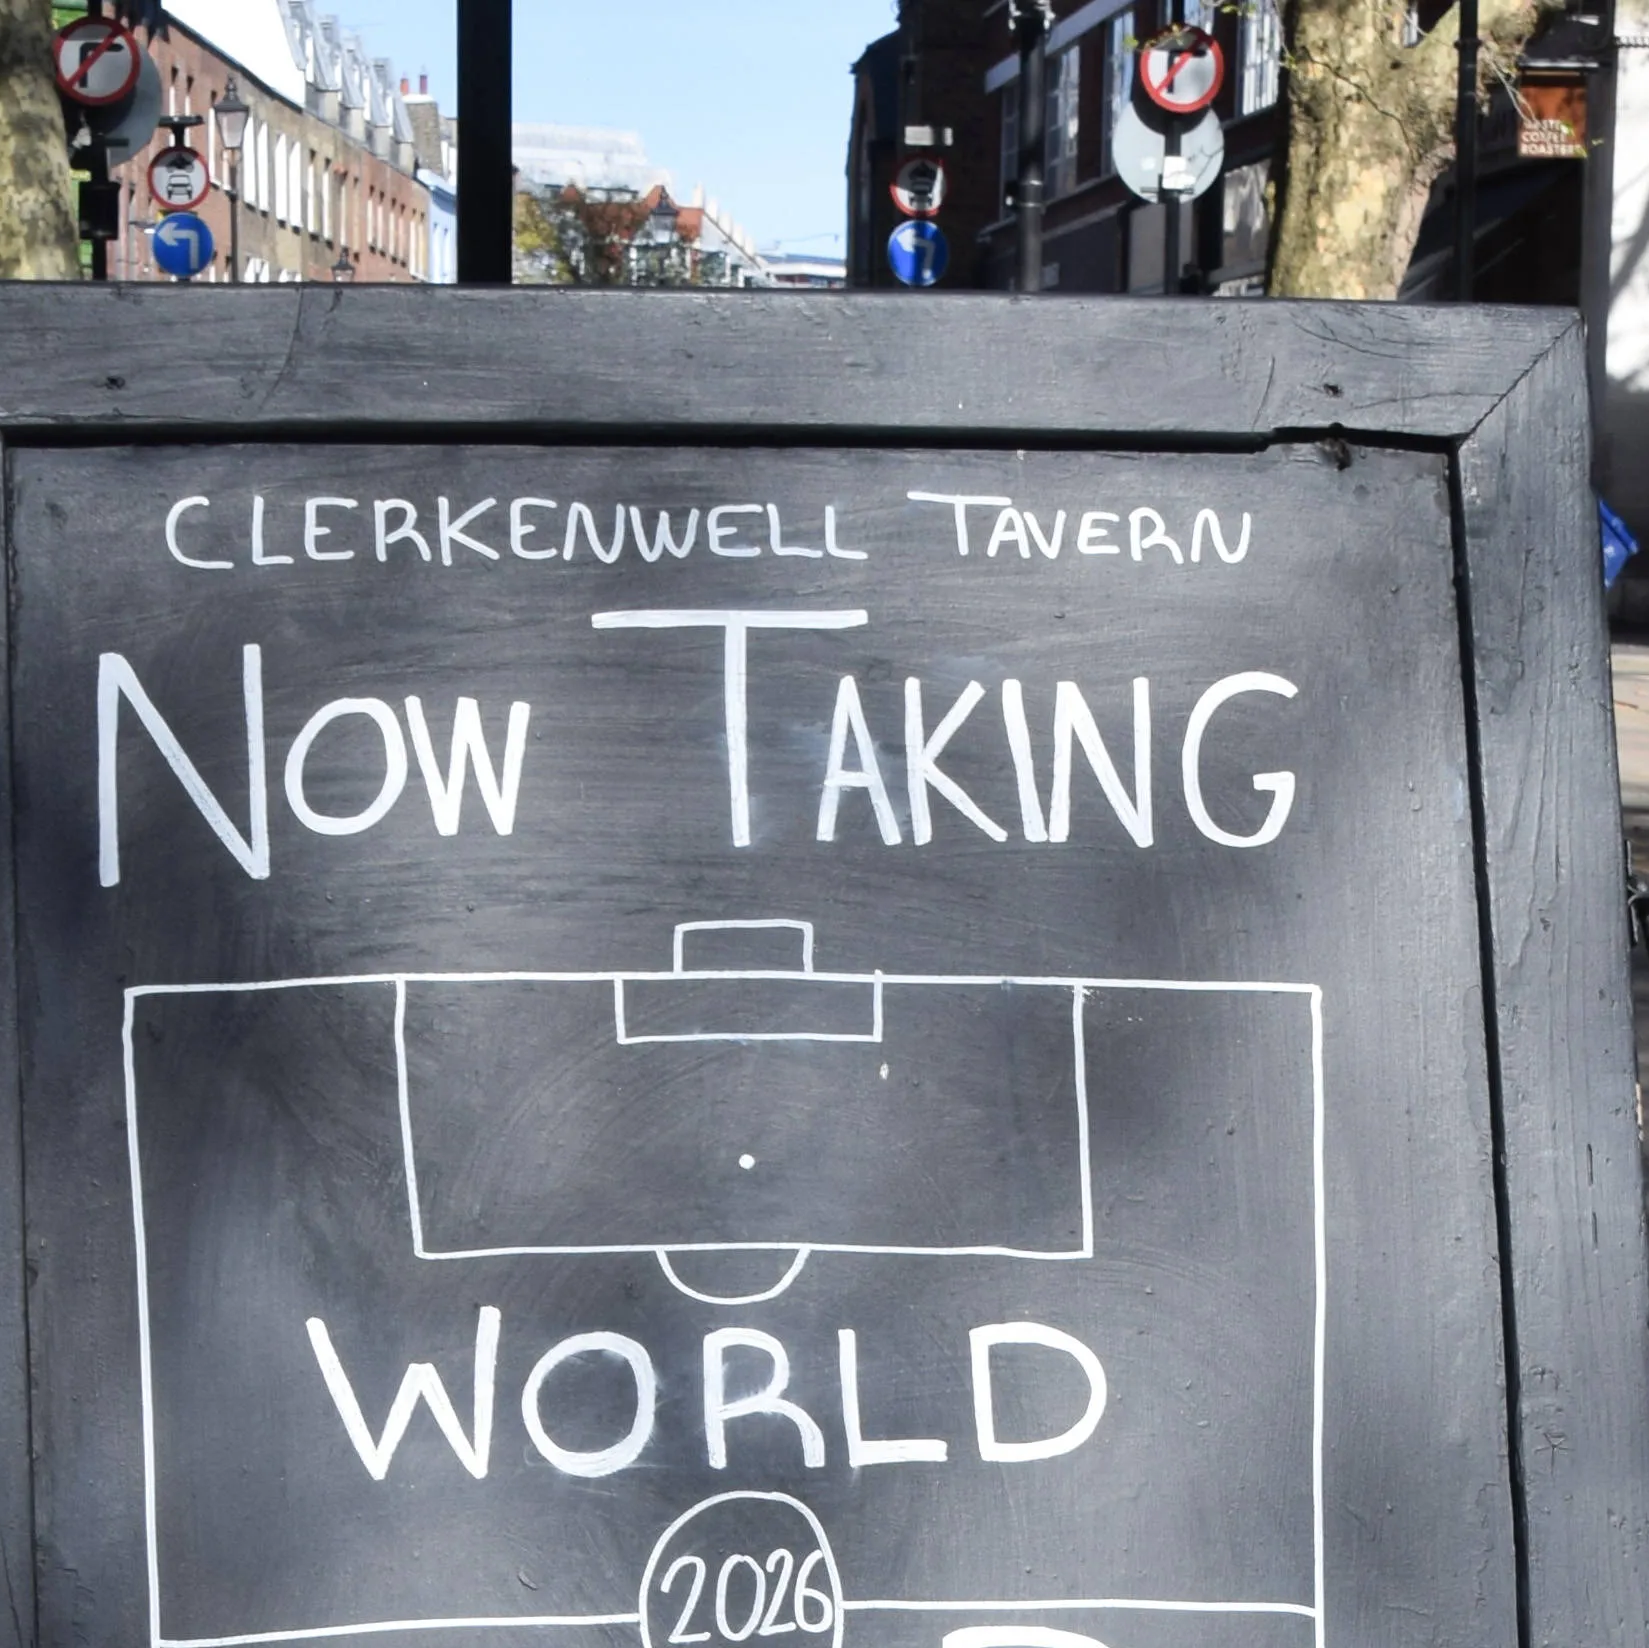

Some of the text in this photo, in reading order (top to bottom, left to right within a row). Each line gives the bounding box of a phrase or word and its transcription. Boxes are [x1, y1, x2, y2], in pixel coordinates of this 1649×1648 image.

[164, 488, 1256, 569] CLERKENWELL TAVERN
[591, 607, 1300, 849] TAKING
[304, 1304, 1109, 1481] WORLD
[659, 1546, 834, 1646] 2026
